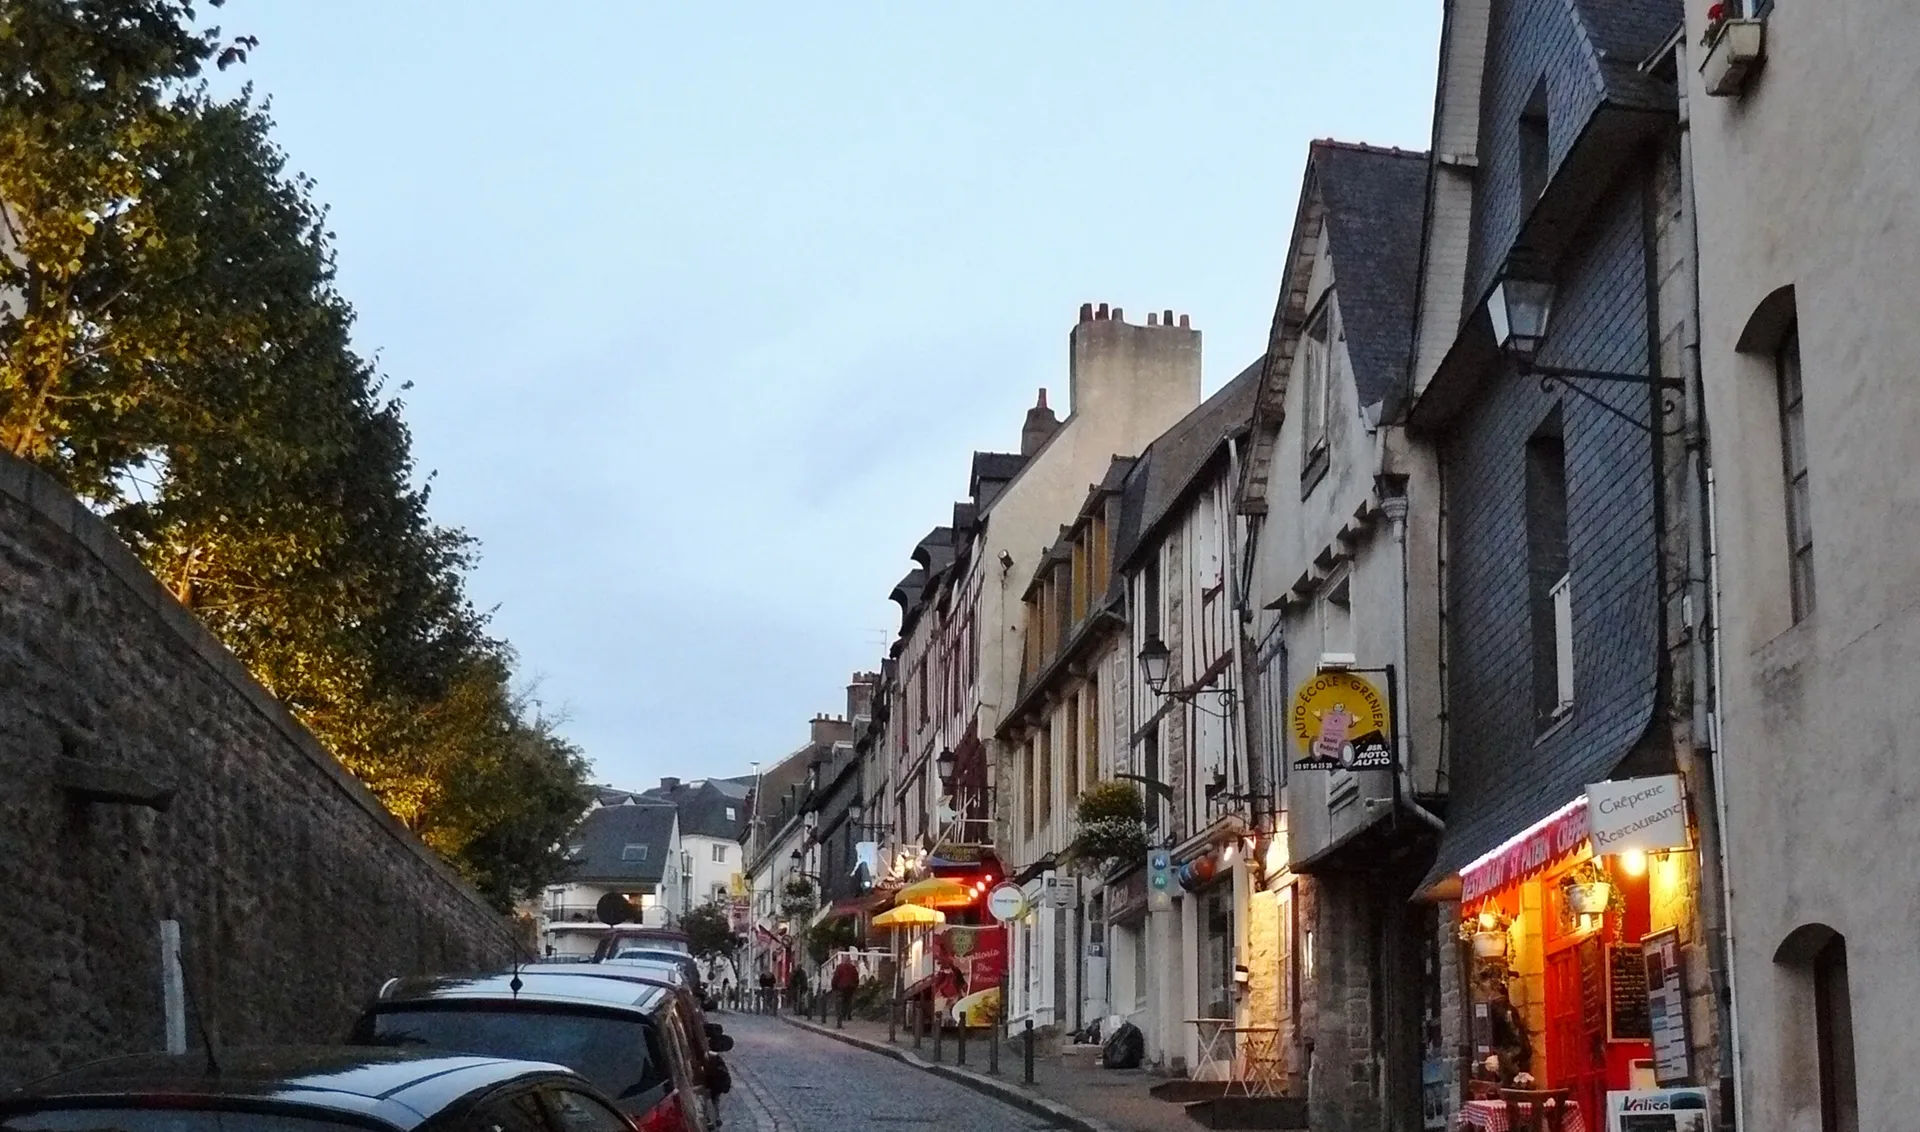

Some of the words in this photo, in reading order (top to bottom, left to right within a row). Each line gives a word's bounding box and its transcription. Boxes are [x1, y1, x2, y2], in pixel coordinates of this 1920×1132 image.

[1350, 680, 1383, 728] GRENIER
[1352, 758, 1390, 766] AUTO
[1357, 751, 1388, 759] MOTO
[1599, 785, 1665, 814] Crêperie
[1595, 804, 1684, 846] Restaurant
